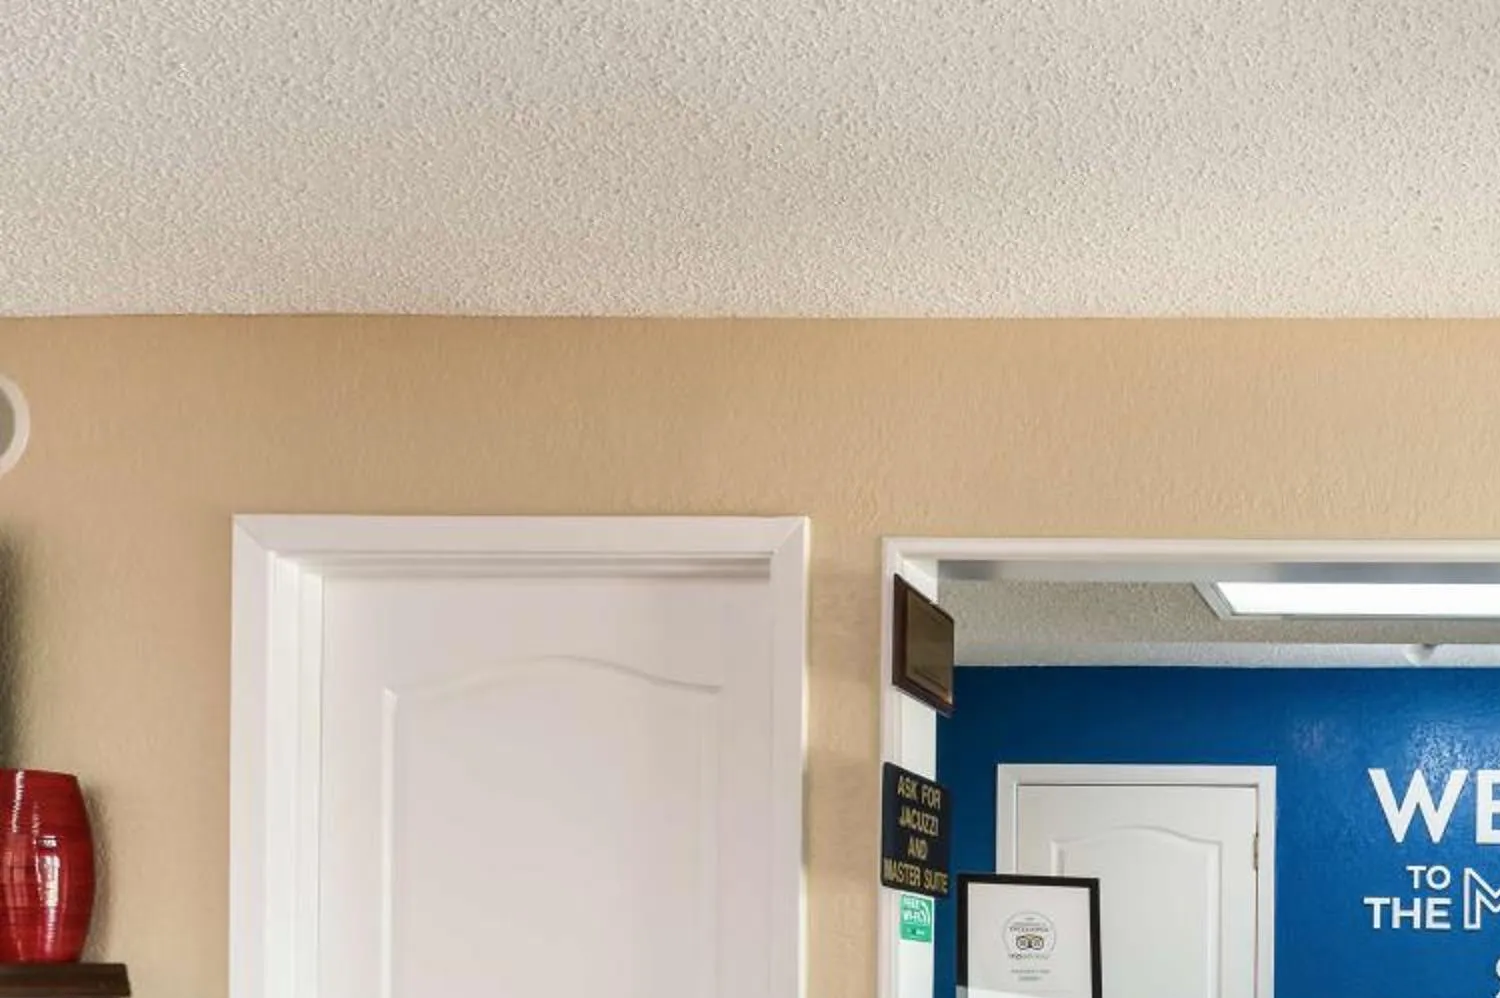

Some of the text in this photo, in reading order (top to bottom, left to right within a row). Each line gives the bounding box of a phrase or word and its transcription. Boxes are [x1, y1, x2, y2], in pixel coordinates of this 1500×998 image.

[897, 775, 941, 808] ASK FOR
[899, 805, 939, 837] JACUZZI
[907, 836, 928, 860] AND
[883, 857, 949, 894] MASTER SUITE
[1406, 865, 1451, 890] TO
[1363, 897, 1452, 930] THE
